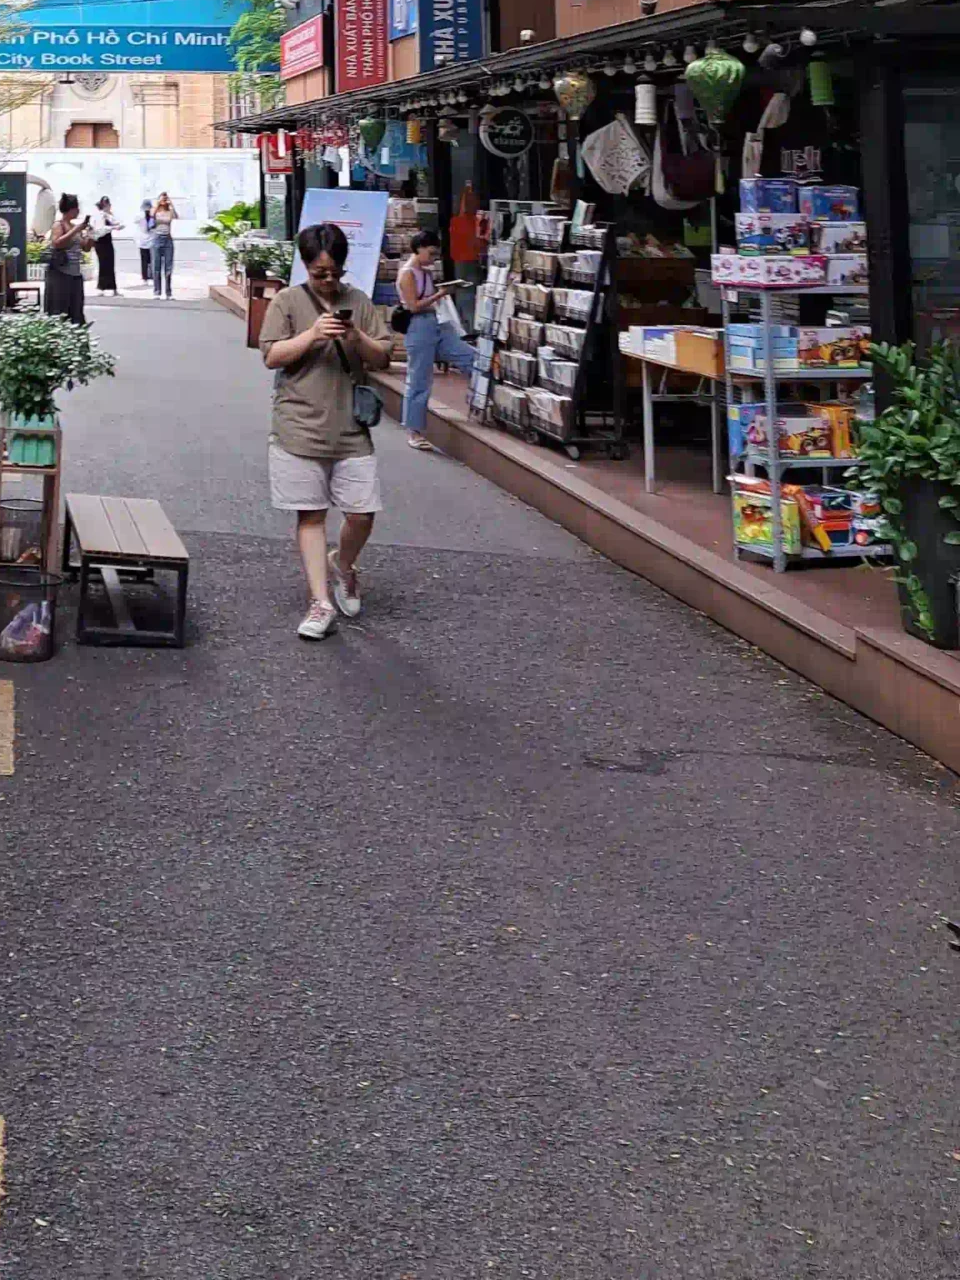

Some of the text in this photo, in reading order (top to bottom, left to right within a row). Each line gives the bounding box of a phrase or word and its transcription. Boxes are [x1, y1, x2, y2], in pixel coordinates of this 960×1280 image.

[358, 11, 374, 36] PHỐ
[33, 28, 80, 45] Phố
[87, 29, 120, 45] Hồ
[127, 31, 168, 45] Chí
[174, 32, 231, 46] Minh
[342, 23, 357, 52] XUẤT
[41, 52, 94, 65] Book
[100, 52, 163, 65] Street
[344, 54, 357, 78] NHÀ
[361, 39, 374, 78] THÀNH
